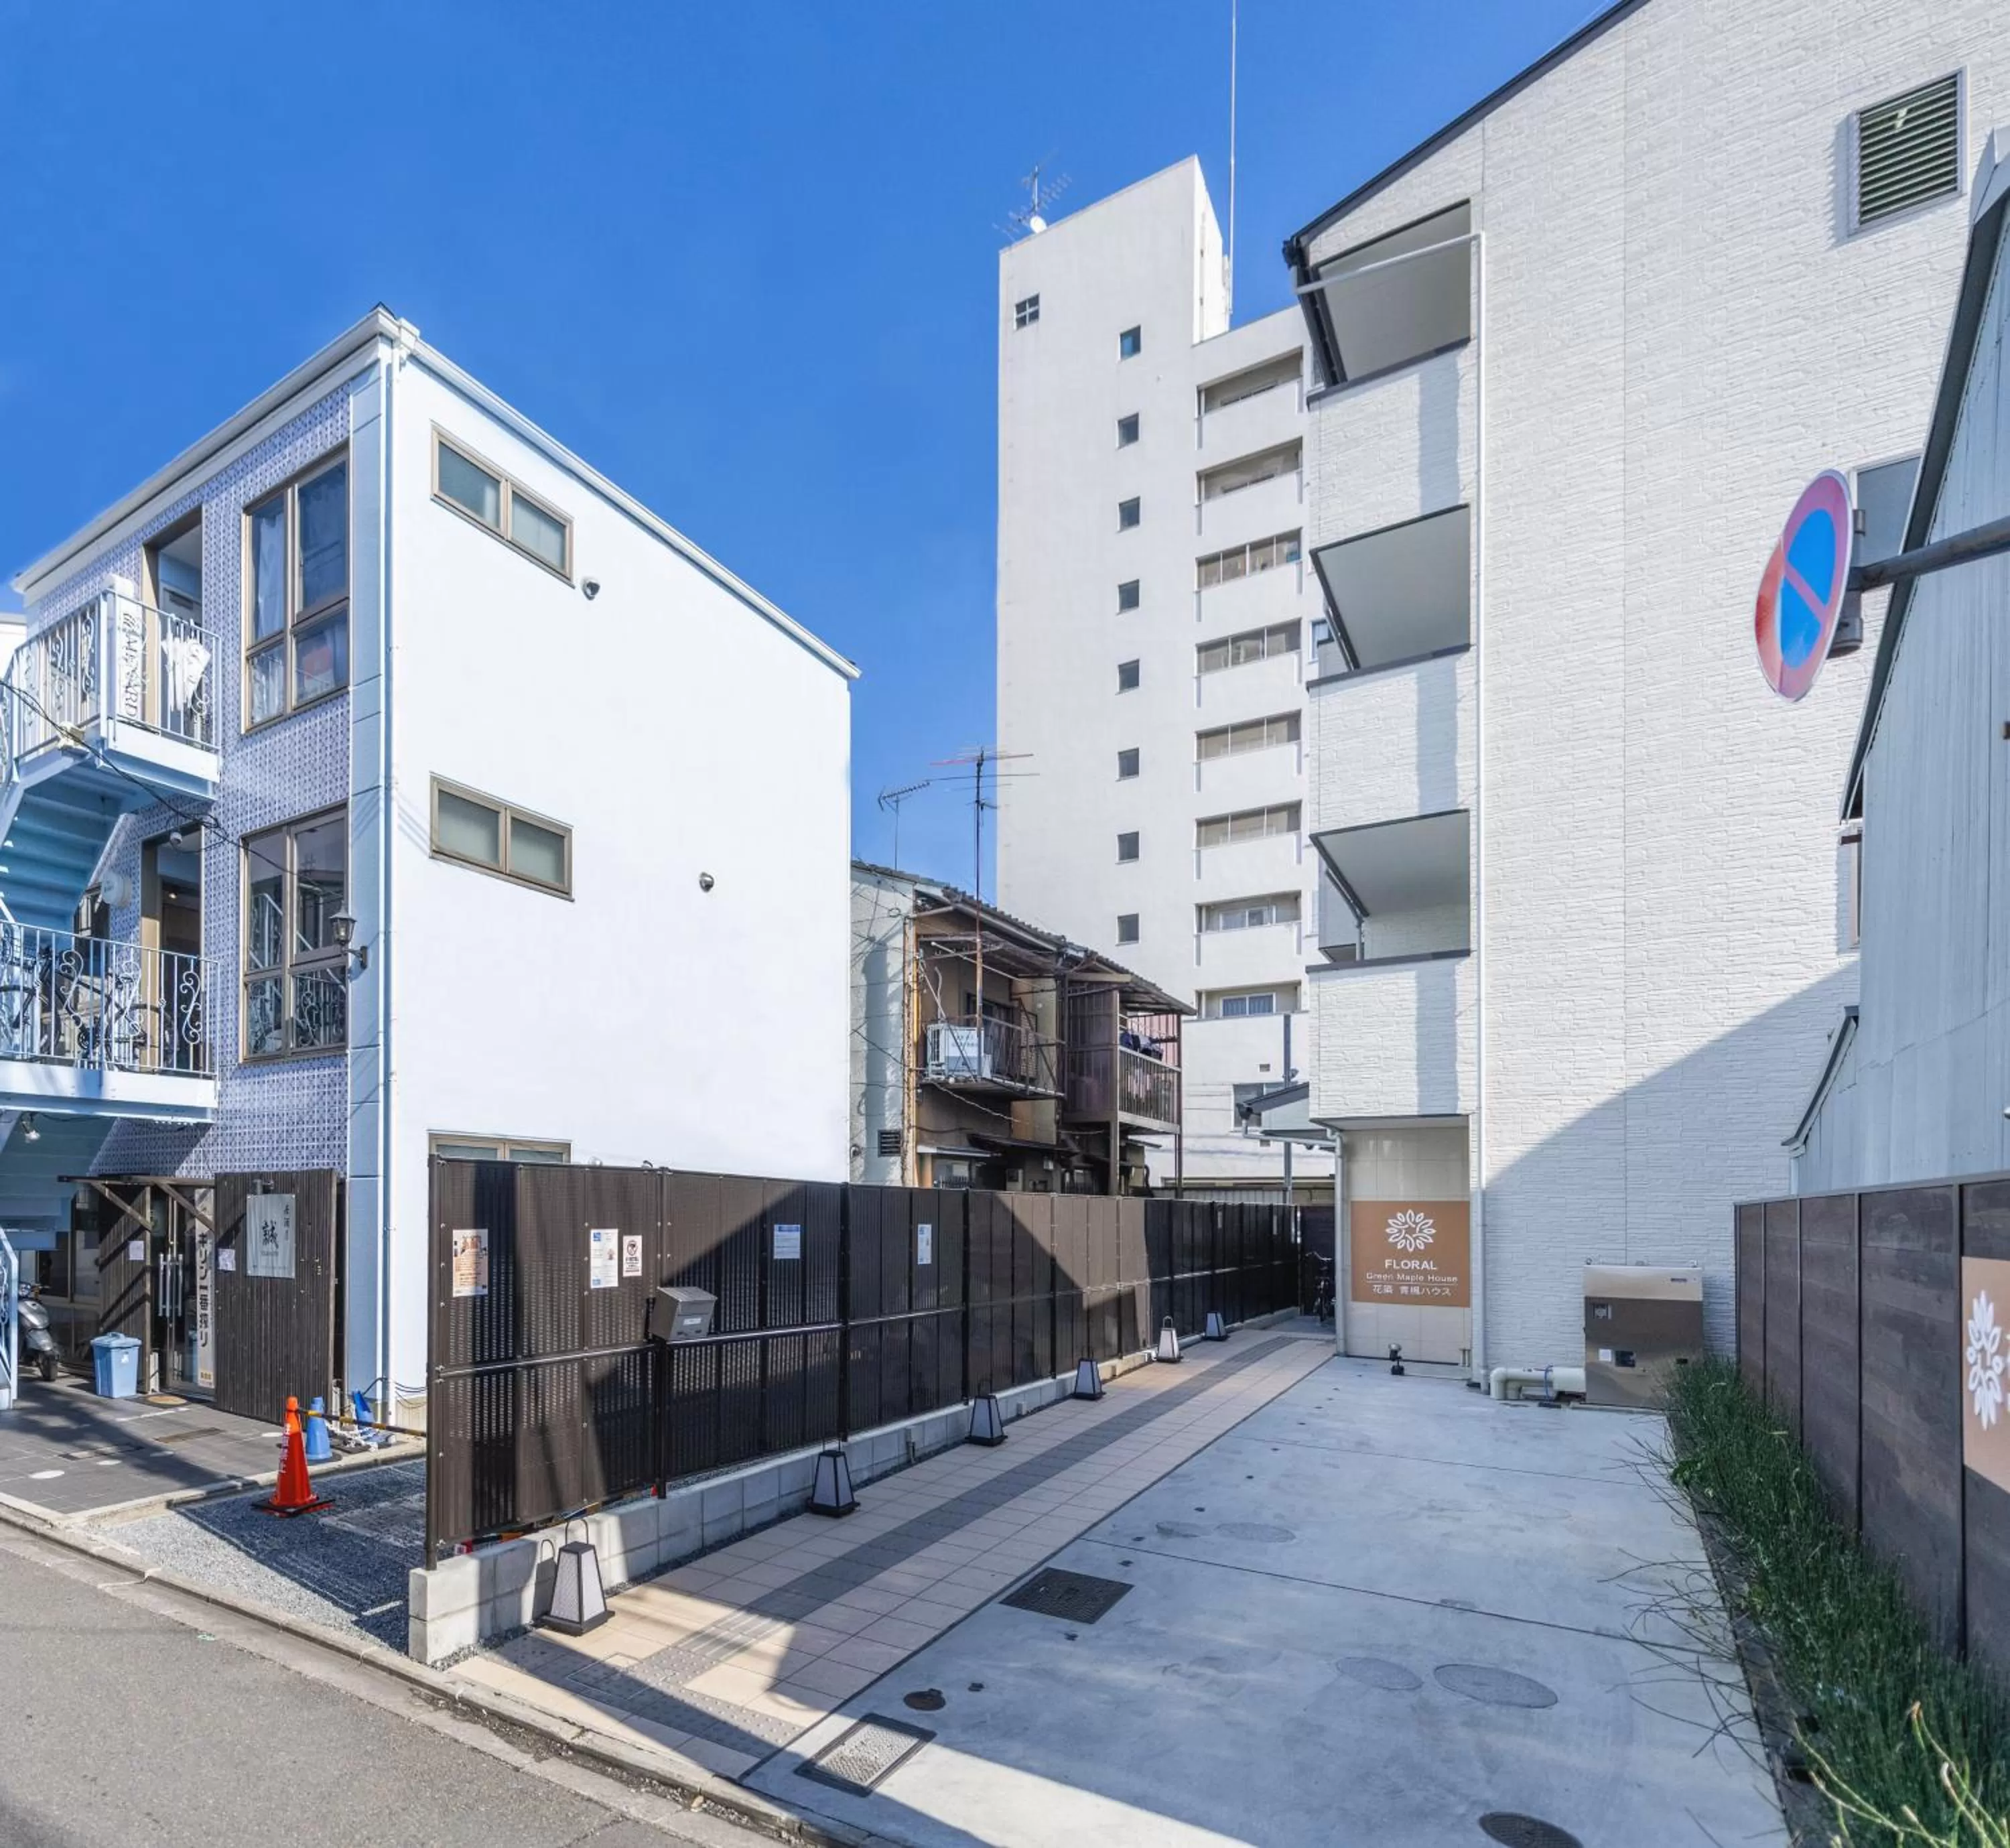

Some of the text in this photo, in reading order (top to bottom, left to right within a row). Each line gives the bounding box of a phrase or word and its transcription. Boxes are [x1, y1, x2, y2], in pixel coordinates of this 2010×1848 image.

[1385, 1259, 1438, 1270] FLORAL
[1366, 1272, 1458, 1282] Green Maple House
